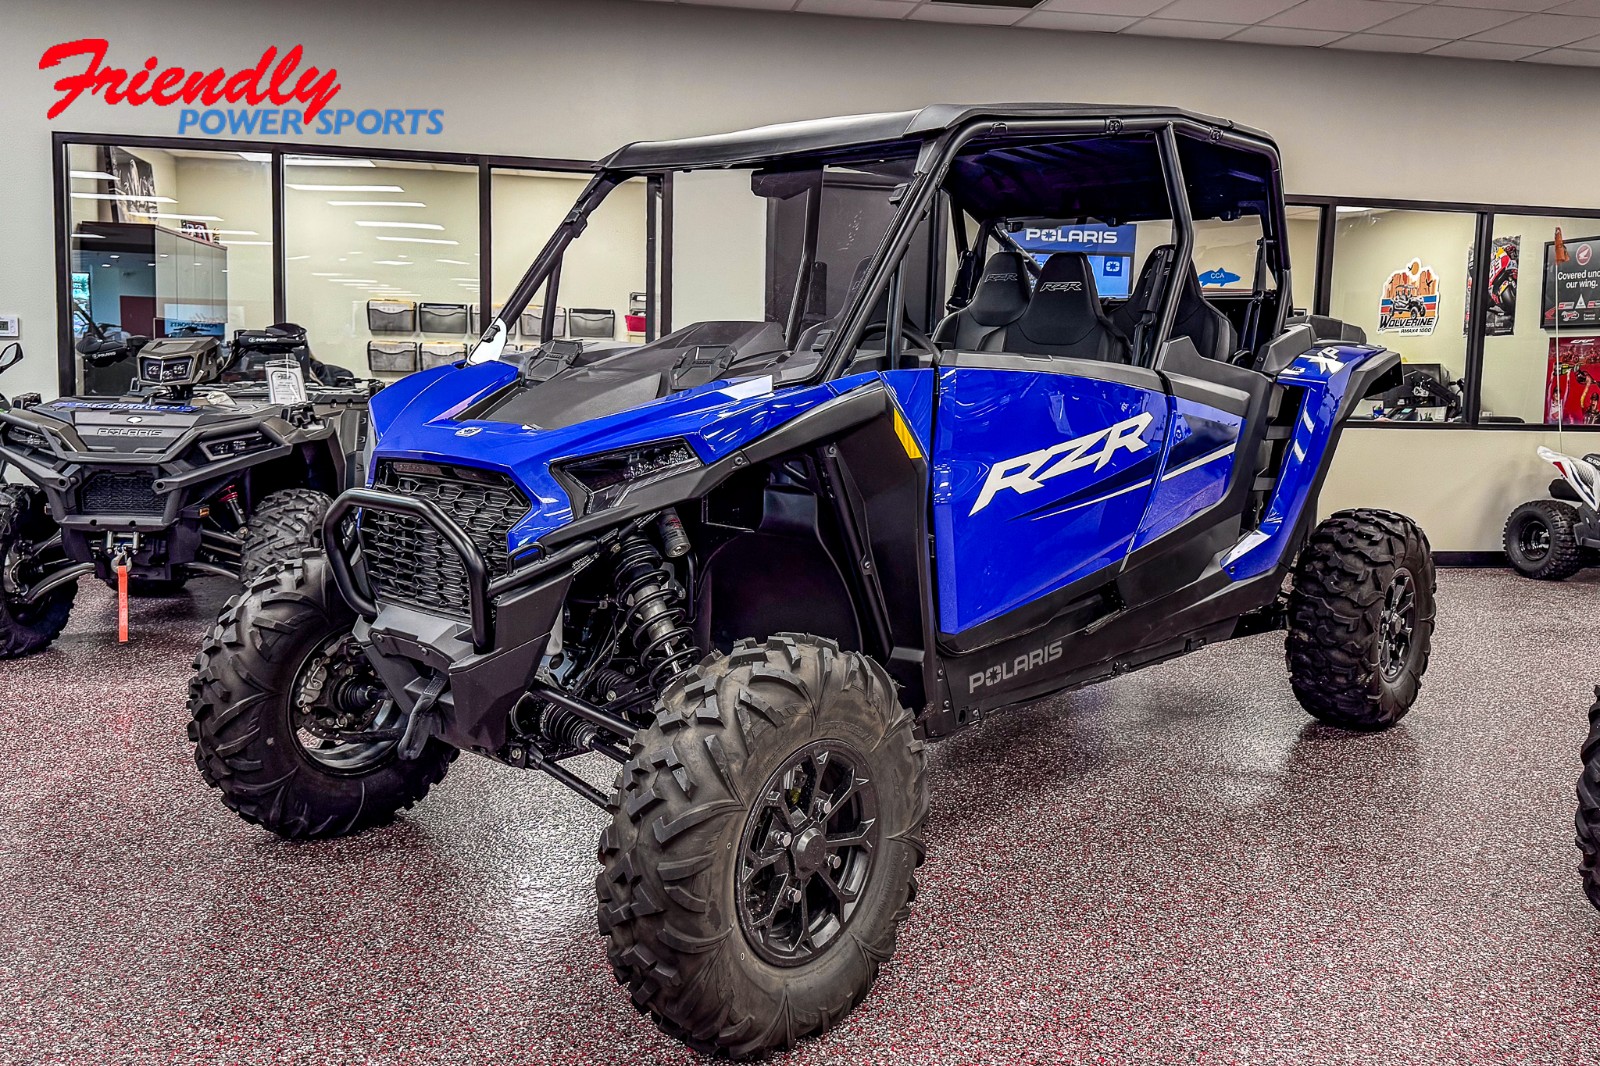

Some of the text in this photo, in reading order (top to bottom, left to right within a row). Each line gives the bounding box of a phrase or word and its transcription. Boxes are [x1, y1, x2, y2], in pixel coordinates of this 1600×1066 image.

[1025, 228, 1118, 244] POLARIS
[1557, 270, 1587, 281] Covered
[1566, 278, 1599, 289] our wing.
[1039, 281, 1082, 293] RZR
[1379, 313, 1435, 329] WOLVERINE
[1302, 346, 1344, 375] XP
[97, 428, 163, 437] POLARIS
[968, 411, 1154, 518] RZR
[968, 640, 1064, 694] POLARIS
